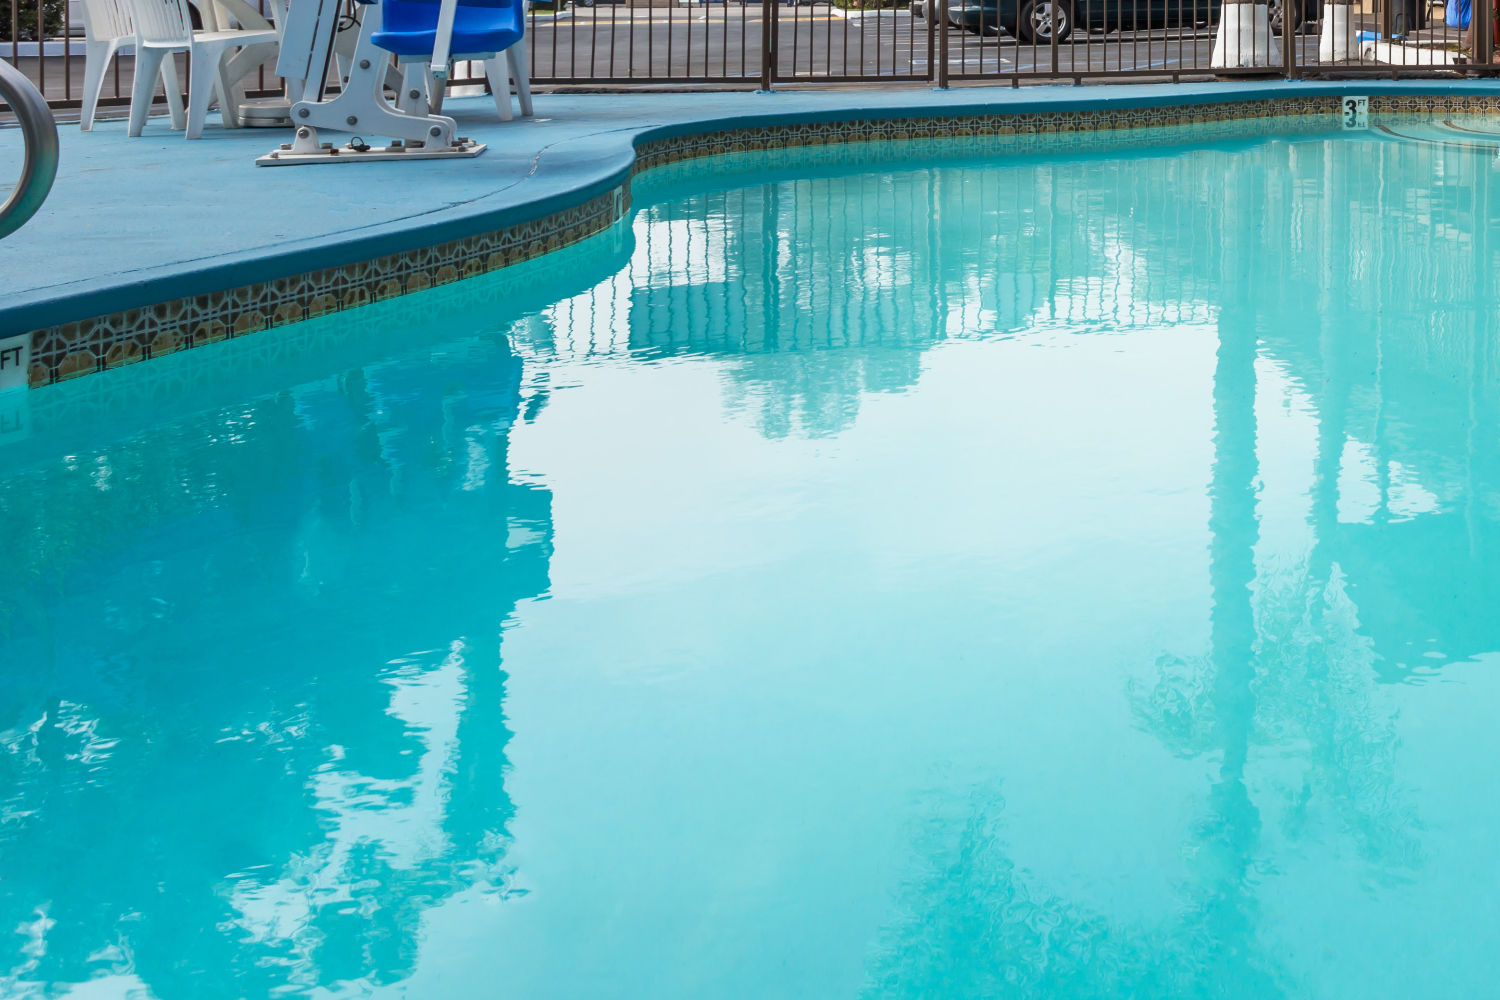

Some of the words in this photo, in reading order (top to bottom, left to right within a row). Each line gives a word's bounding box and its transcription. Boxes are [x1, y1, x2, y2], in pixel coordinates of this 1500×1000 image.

[1344, 99, 1357, 115] 3
[1357, 99, 1366, 107] FT
[0, 345, 24, 370] FT
